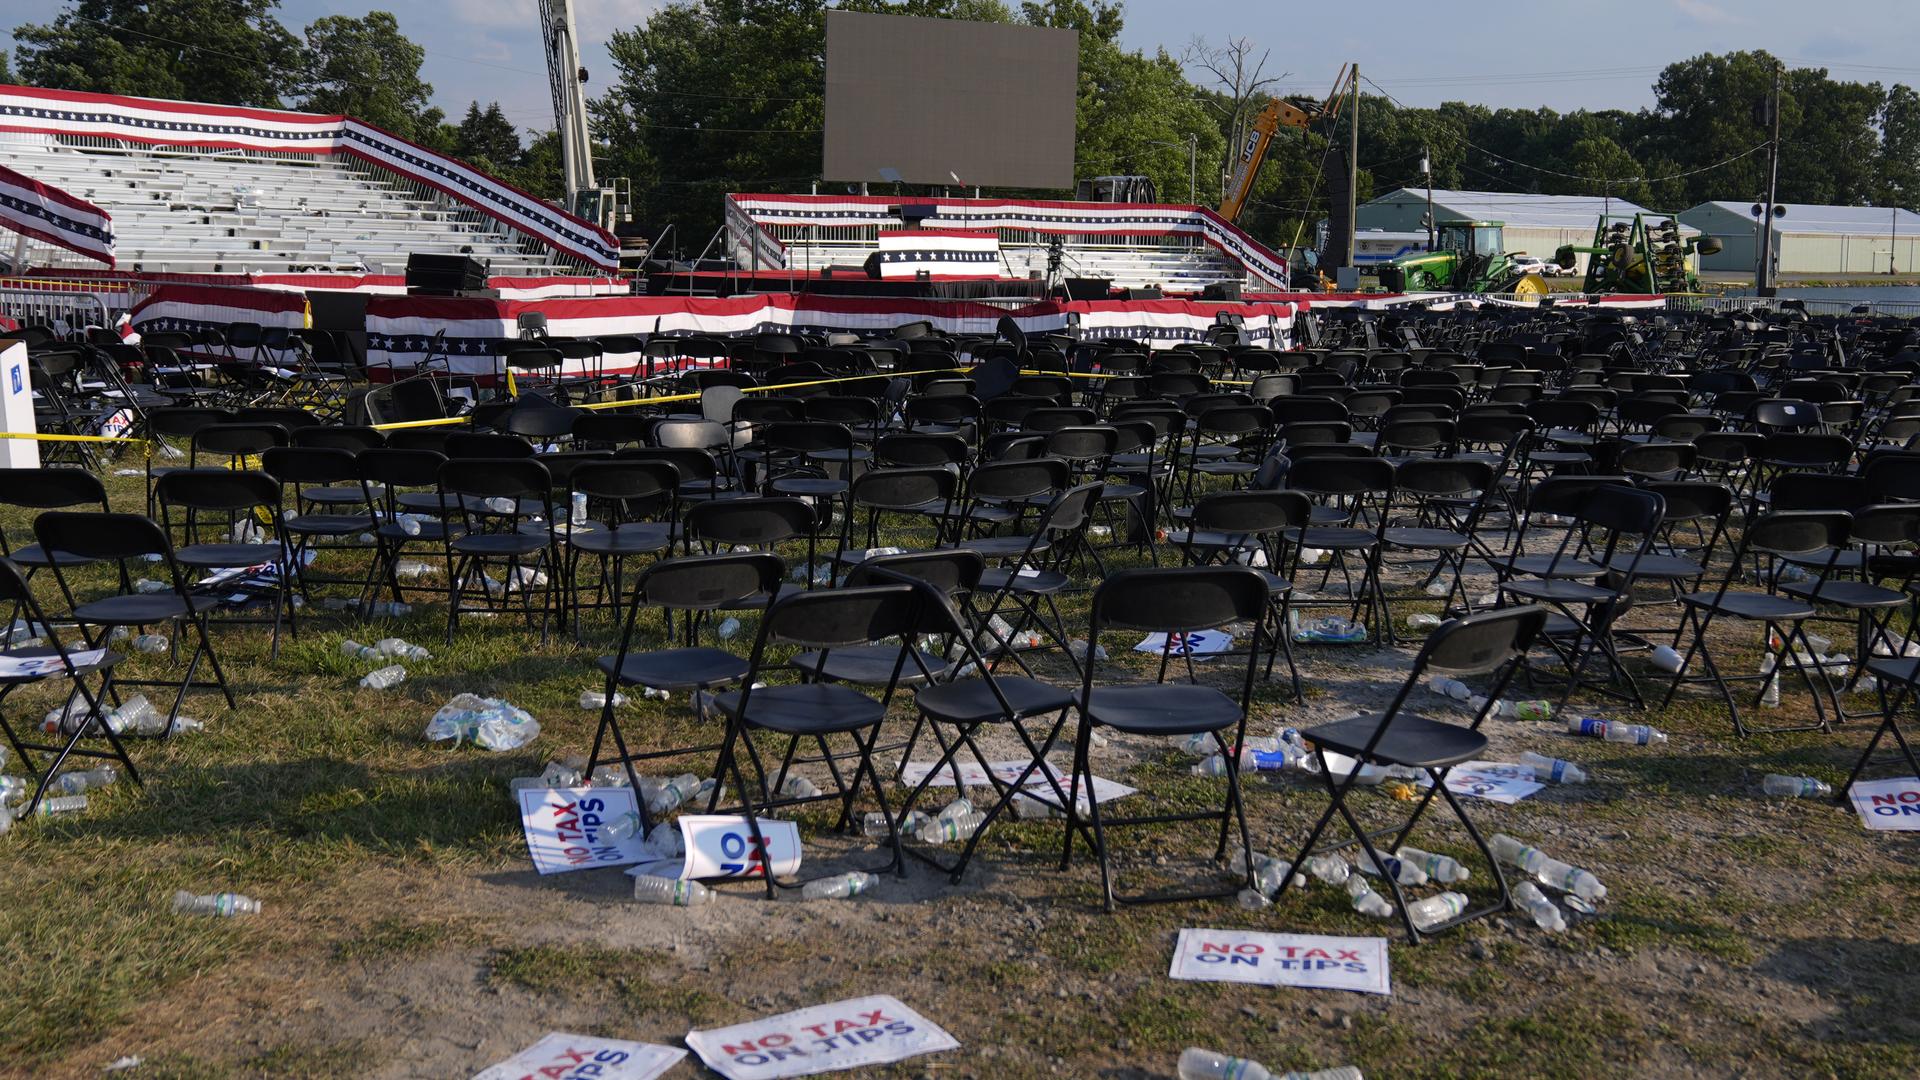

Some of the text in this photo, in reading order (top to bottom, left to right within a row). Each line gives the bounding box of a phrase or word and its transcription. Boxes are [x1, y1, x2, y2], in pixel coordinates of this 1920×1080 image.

[1244, 130, 1260, 162] JCB
[104, 424, 128, 434] TIP
[1871, 791, 1920, 806] NO
[551, 801, 582, 842] TAX
[579, 798, 624, 861] ON TIPS
[1196, 954, 1367, 973] ON TIPS
[1202, 942, 1360, 961] NO TAX
[721, 1010, 892, 1055] NO TAX
[734, 1021, 915, 1066] ON TIPS
